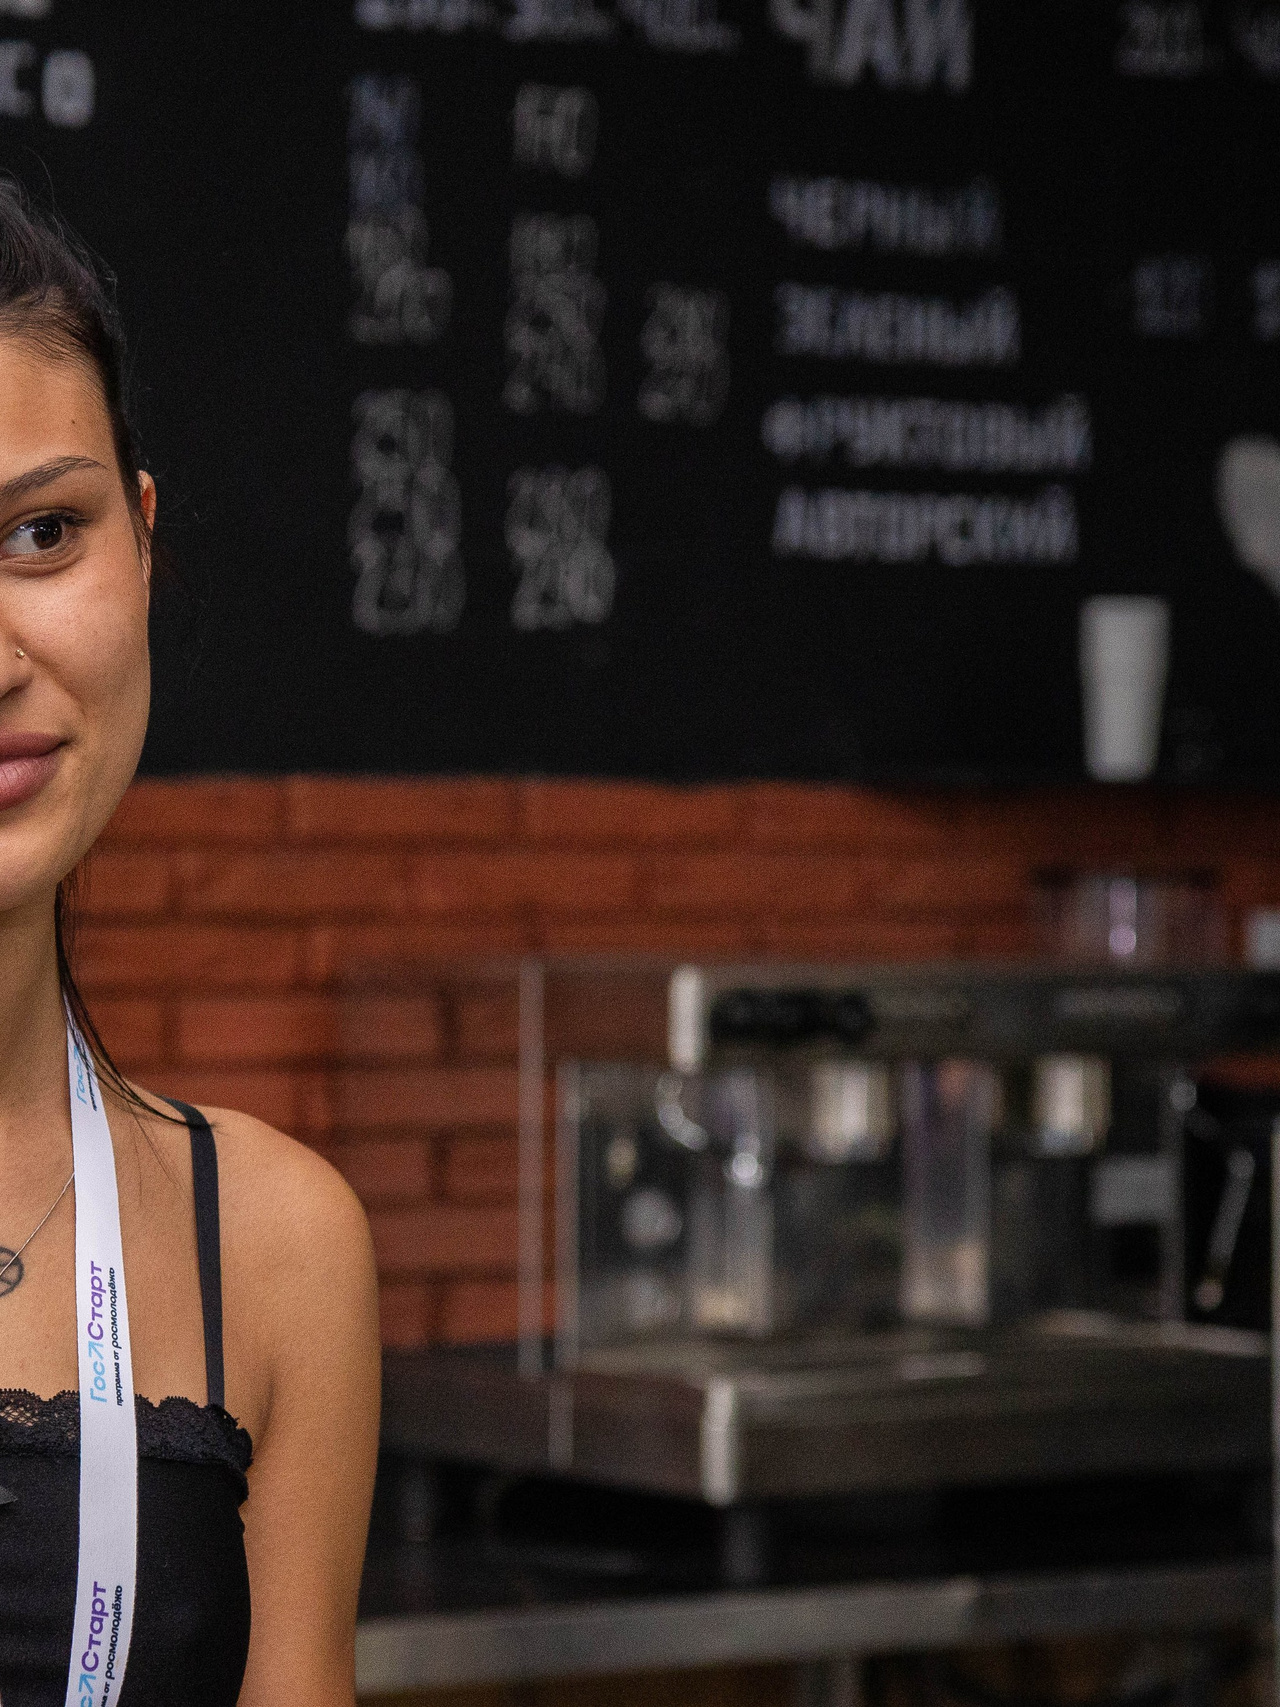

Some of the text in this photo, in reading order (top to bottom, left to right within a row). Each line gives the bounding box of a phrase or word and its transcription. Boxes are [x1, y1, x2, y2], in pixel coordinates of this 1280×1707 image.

[107, 1267, 122, 1350] росмолодёжь
[113, 1350, 120, 1361] от
[105, 1585, 123, 1681] росмолодёжь
